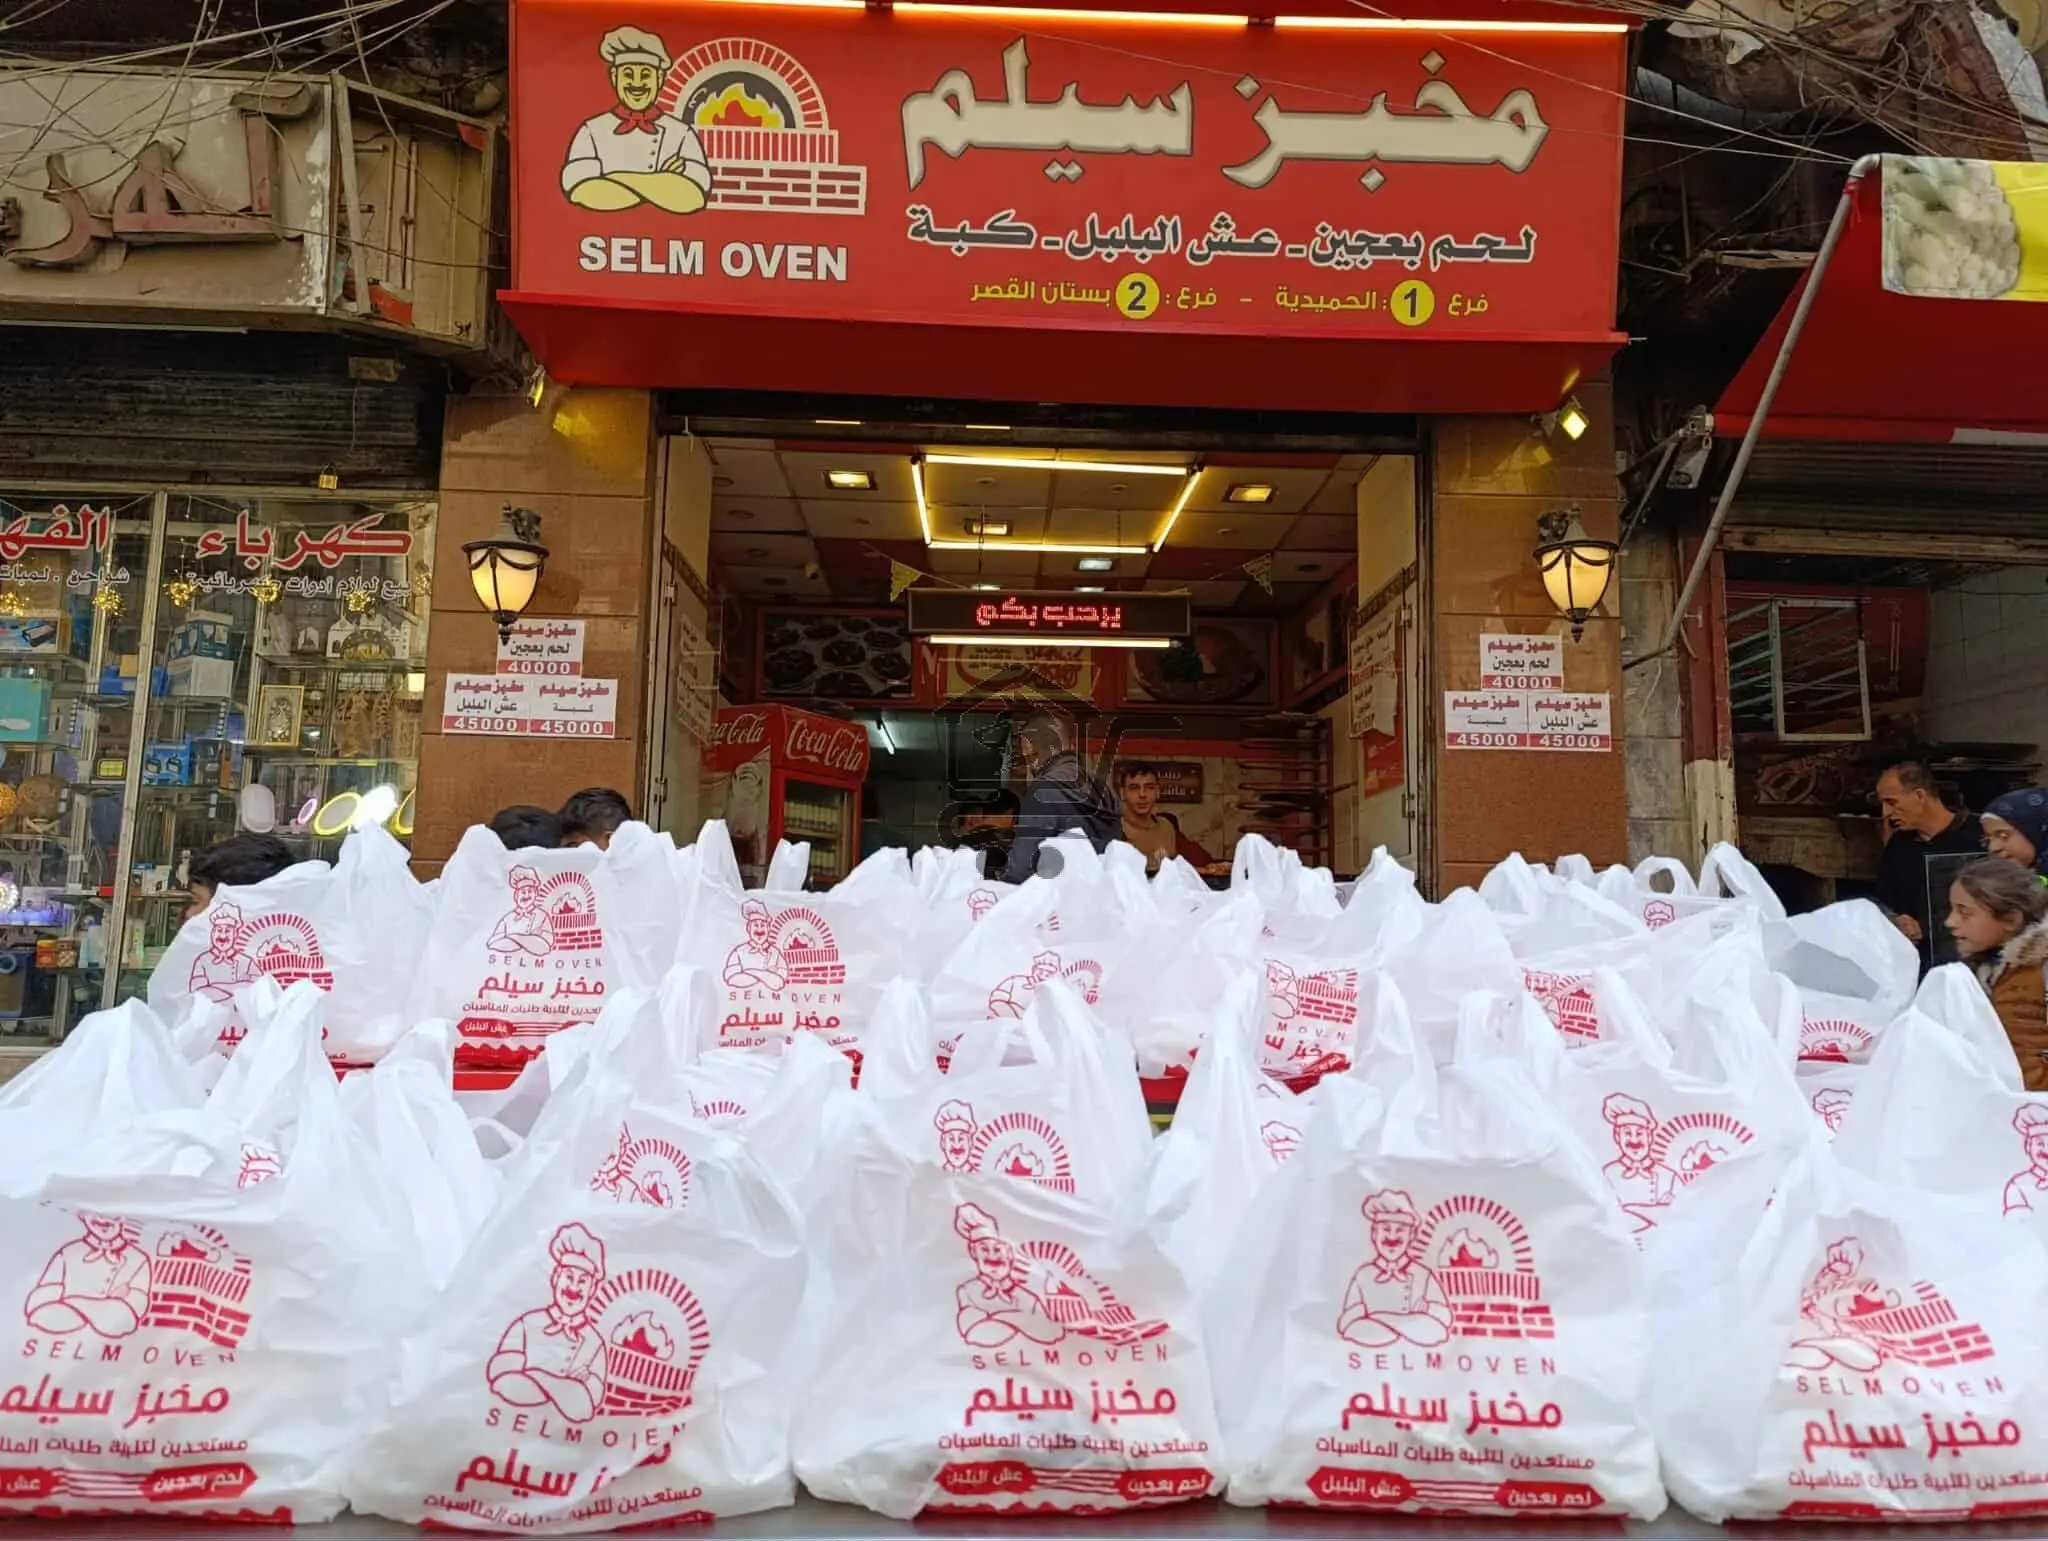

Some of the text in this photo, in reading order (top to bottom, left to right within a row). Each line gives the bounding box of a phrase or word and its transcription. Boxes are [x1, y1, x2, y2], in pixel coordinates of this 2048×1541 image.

[901, 34, 1550, 192] مخبز سيلم
[906, 204, 1038, 257] كبة
[1066, 212, 1182, 263] البلبل
[1187, 211, 1281, 265] عش
[579, 235, 848, 281] SELM OVEN
[1308, 222, 1424, 271] بعجين
[1430, 224, 1537, 273] لحم
[970, 276, 1036, 302] القصر
[1041, 281, 1112, 309] بستان
[1176, 287, 1218, 310] فرع
[1275, 286, 1377, 313] الحميدية
[1447, 294, 1490, 316] فرع
[0, 503, 111, 560] الفه
[196, 509, 414, 570] كهرباء
[976, 597, 1121, 629] يرحب بكم
[510, 640, 570, 657] لحم بعجين
[507, 661, 571, 674] 40000
[1493, 656, 1550, 672] لحم بعجين
[1492, 676, 1552, 689] 40000
[456, 696, 518, 714] عش البلبل
[454, 717, 518, 732] 45000
[540, 720, 604, 734] 45000
[1540, 712, 1598, 731] عش البلبل
[1456, 733, 1518, 746] 45000
[1539, 735, 1600, 748] 45000
[488, 954, 545, 968] SELM
[478, 972, 605, 999] مخبز سيلم
[729, 990, 781, 1001] SELM
[720, 1006, 841, 1036] مخبز سيلم
[23, 1338, 236, 1367] SELM OVEN
[972, 1343, 1168, 1370] SELM OVEN
[1349, 1352, 1556, 1376] SELM OVEN
[1796, 1375, 2004, 1398] SELM OVEN
[123, 1383, 230, 1430] مخبز
[964, 1377, 1177, 1427] مخبز سيلم
[1341, 1382, 1563, 1436] مخبز سيلم
[486, 1407, 583, 1443] SELM
[1803, 1408, 2021, 1463] مخبز سيلم
[46, 1437, 102, 1456] طلبات
[938, 1432, 1021, 1452] المناسبات
[1027, 1433, 1077, 1452] طلبات
[1129, 1438, 1209, 1458] مستعدين
[1316, 1436, 1595, 1470] مستعدين لتلبية طلبات المناسبات
[6, 1474, 41, 1492] عش
[210, 1467, 245, 1491] لحم
[456, 1448, 578, 1499] سيلم
[1177, 1475, 1207, 1495] لحم
[1320, 1474, 1401, 1497] عش البلبل
[618, 1485, 703, 1516] مستعدين
